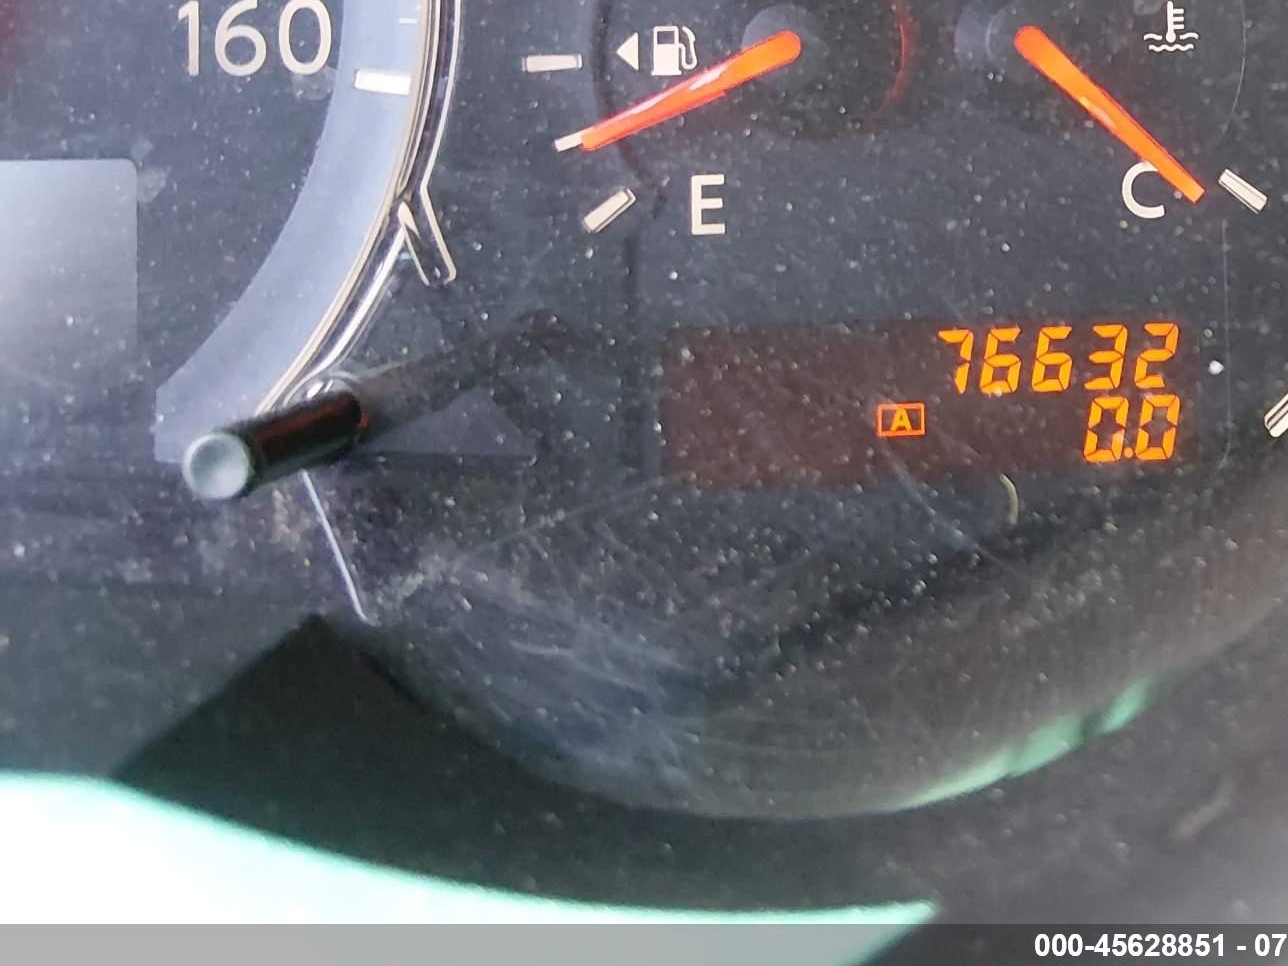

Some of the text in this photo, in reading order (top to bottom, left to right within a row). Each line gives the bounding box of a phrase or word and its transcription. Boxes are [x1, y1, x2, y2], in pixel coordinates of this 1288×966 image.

[691, 174, 727, 236] E
[1121, 160, 1165, 219] C
[938, 322, 1181, 395] 76632
[889, 407, 912, 432] A
[1083, 394, 1181, 463] 0.0
